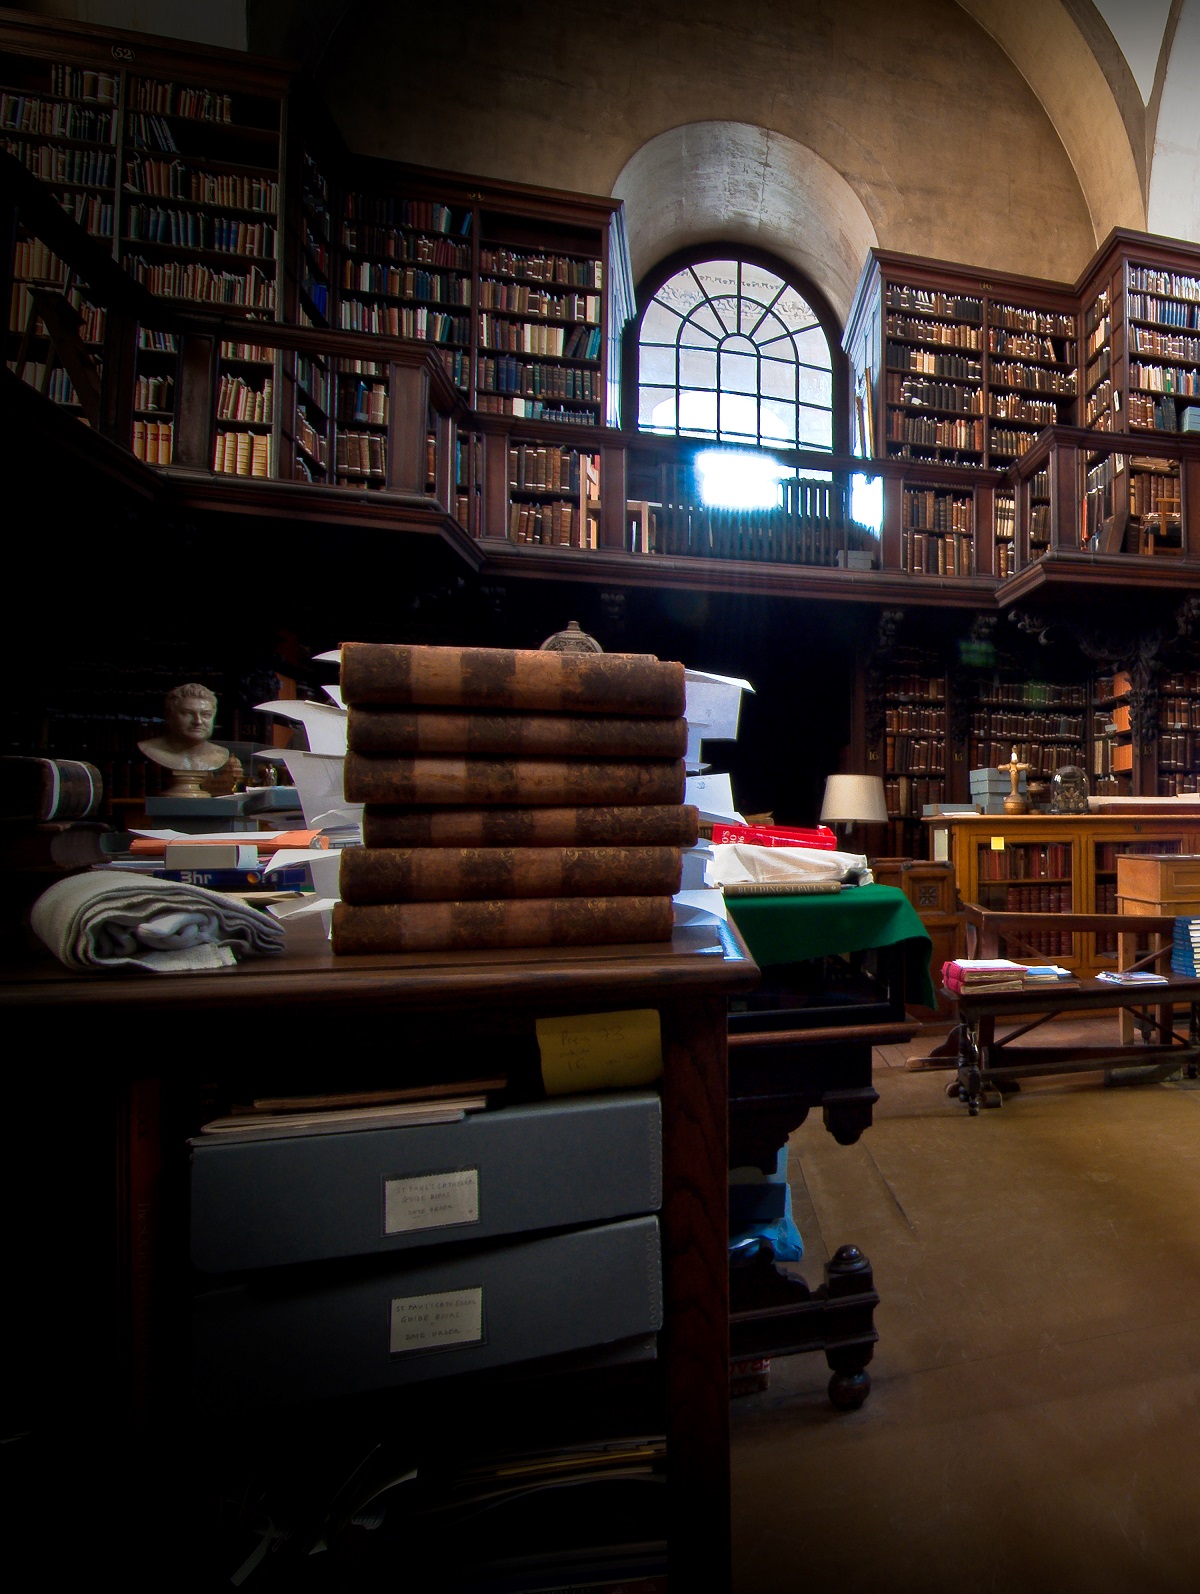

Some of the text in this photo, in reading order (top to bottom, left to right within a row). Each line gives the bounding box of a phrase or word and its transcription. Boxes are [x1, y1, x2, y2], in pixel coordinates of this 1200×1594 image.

[114, 46, 134, 60] 52
[869, 751, 879, 761] 16
[180, 871, 212, 884] 3hr
[401, 1314, 430, 1323] GUIDE
